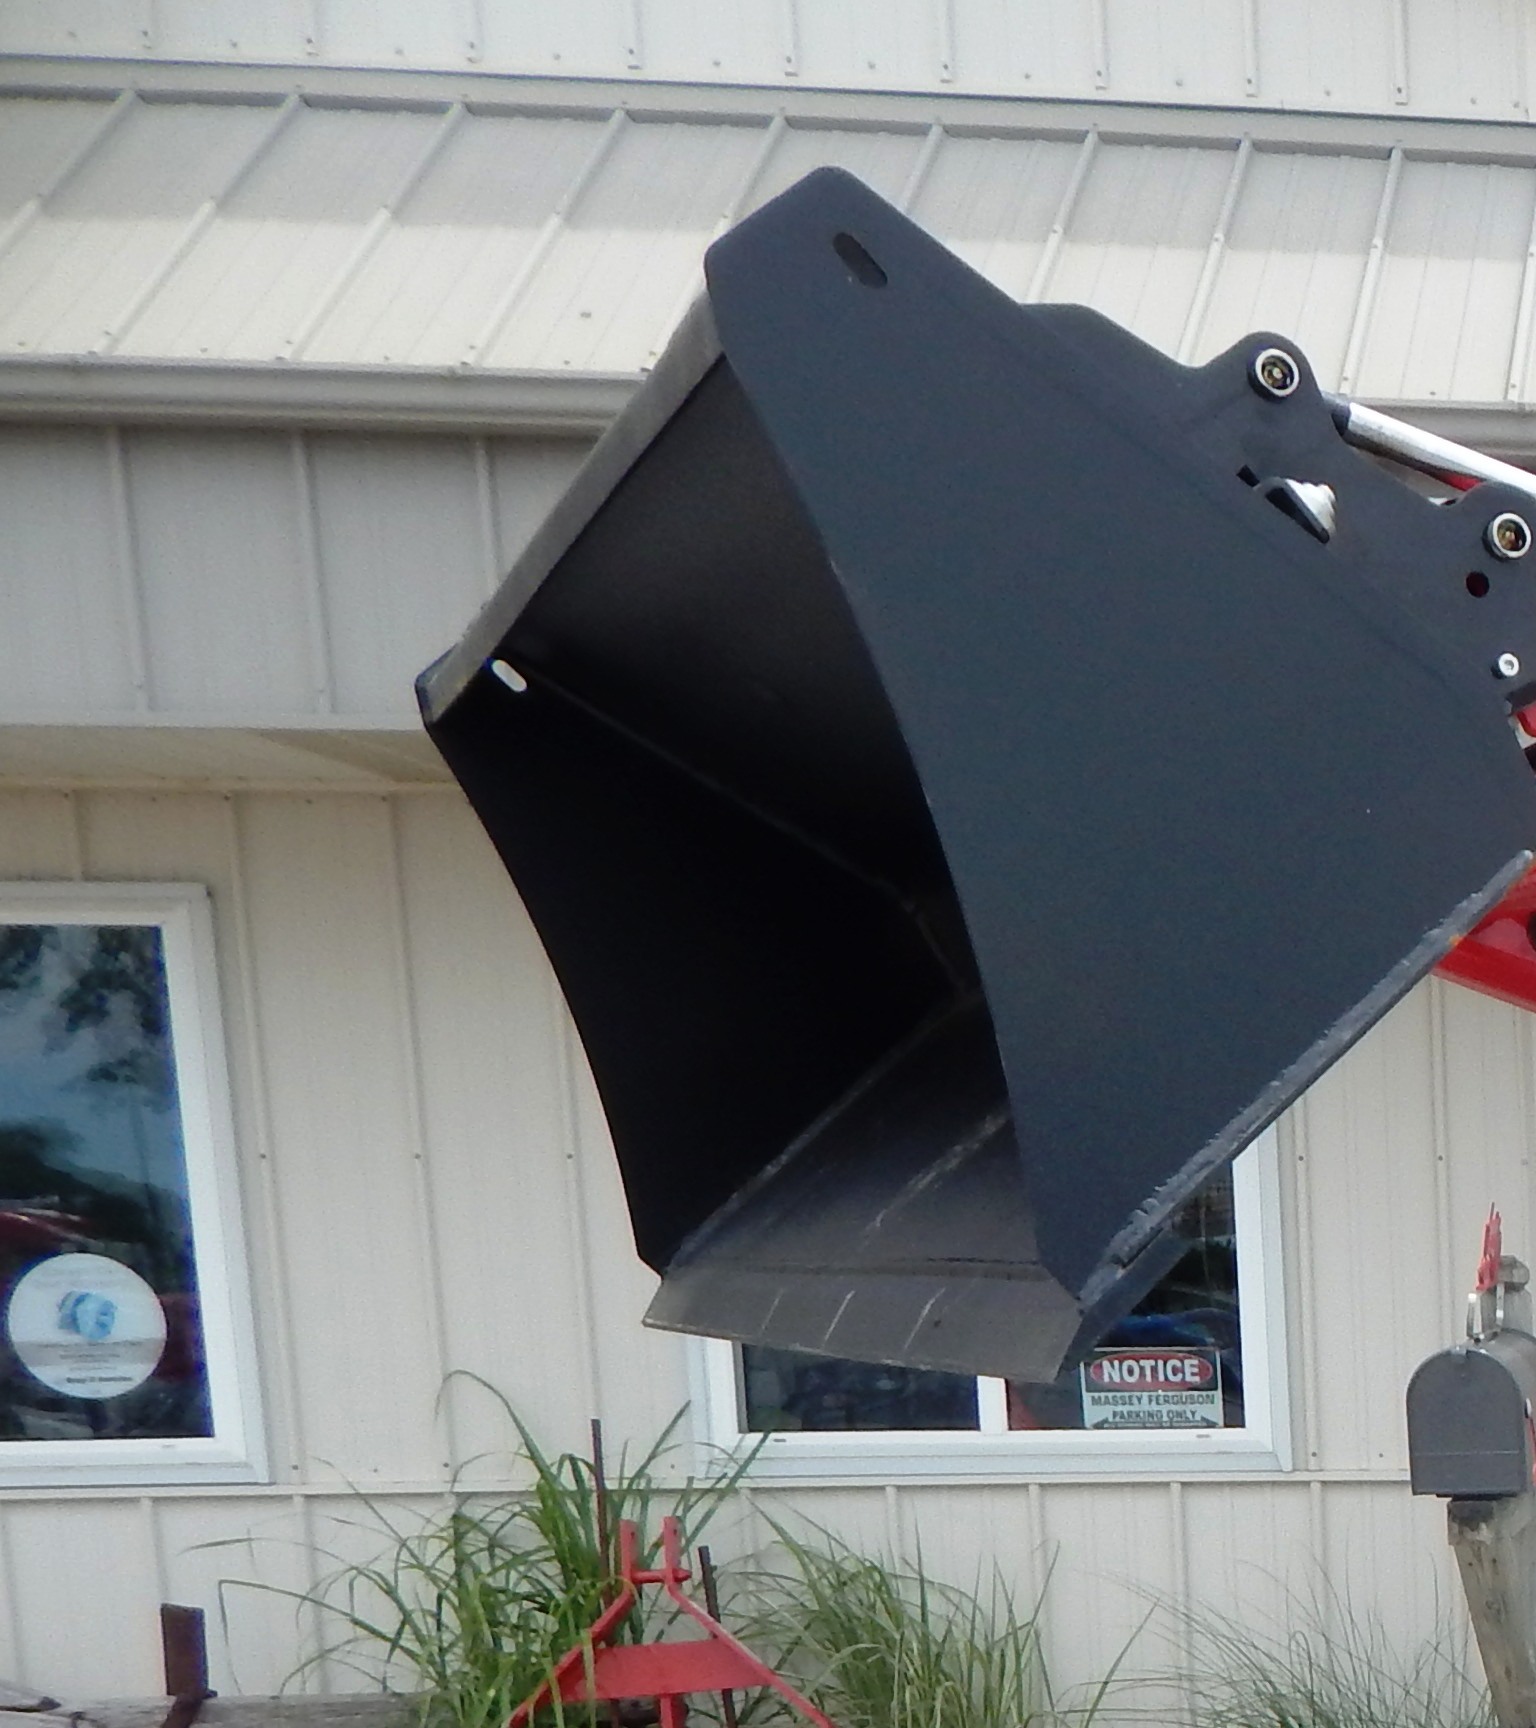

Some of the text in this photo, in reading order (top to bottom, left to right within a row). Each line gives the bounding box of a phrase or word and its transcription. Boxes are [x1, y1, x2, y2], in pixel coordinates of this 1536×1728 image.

[1101, 1358, 1200, 1383] NOTICE
[1091, 1393, 1215, 1406] MASSEY FERGUSON
[1112, 1409, 1198, 1421] PARKING ONLY
